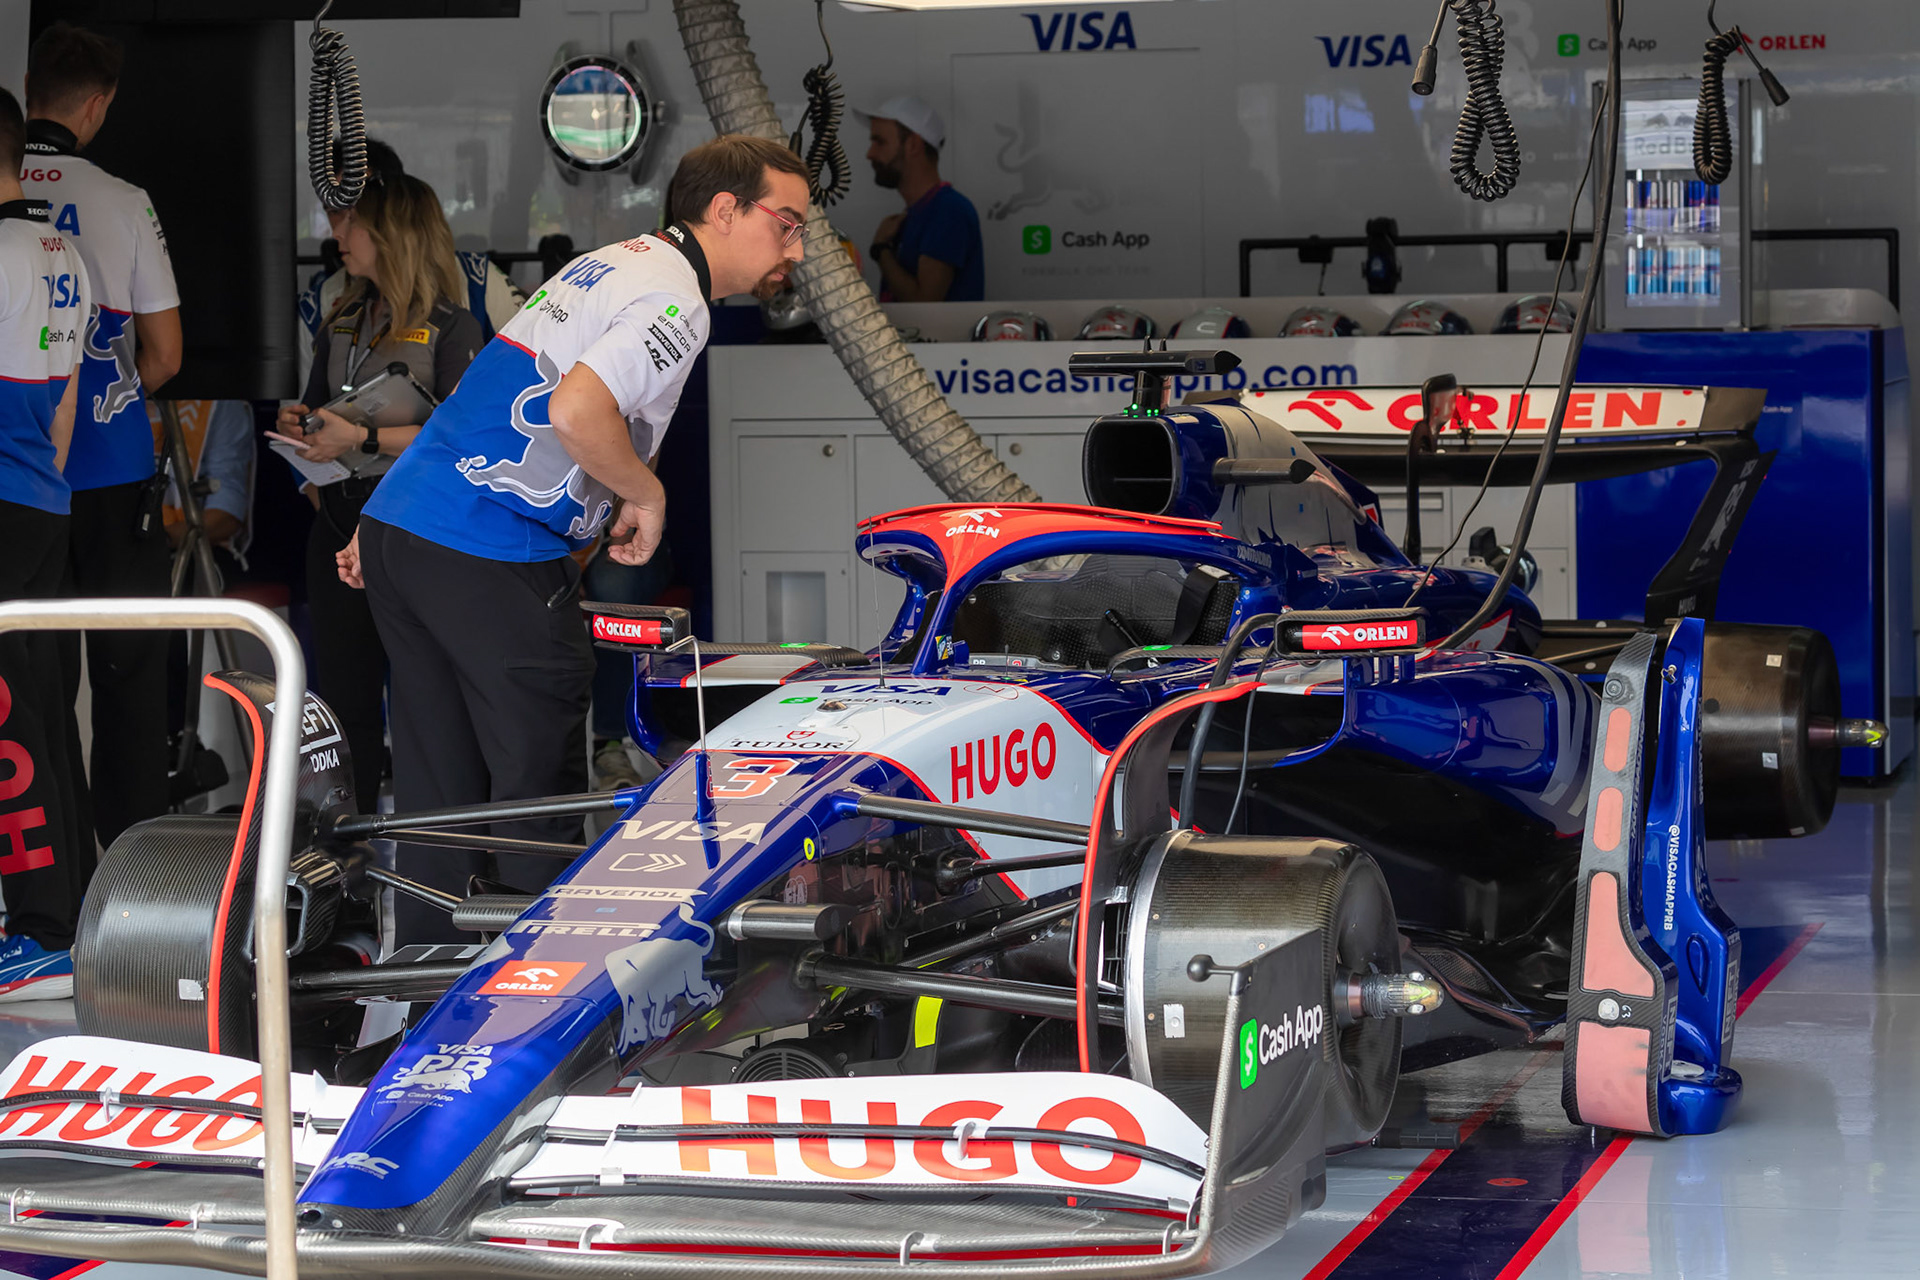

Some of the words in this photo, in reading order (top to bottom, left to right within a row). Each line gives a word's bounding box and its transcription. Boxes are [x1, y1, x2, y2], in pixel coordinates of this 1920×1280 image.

[1021, 11, 1137, 52] VISA
[1314, 34, 1411, 67] VISA
[1627, 37, 1657, 51] App
[1760, 34, 1826, 51] ORLEN
[20, 169, 62, 182] UGO
[1062, 231, 1107, 248] Cash
[1112, 230, 1150, 250] App
[560, 256, 616, 292] VISA
[550, 303, 569, 323] App
[936, 359, 1358, 399] visacashapb.com
[945, 525, 1001, 539] ORLEN
[606, 621, 642, 638] ORLEN
[1353, 626, 1408, 642] ORLEN
[818, 684, 953, 696] VISA
[302, 702, 330, 738] EFT
[730, 740, 845, 750] TUDOR
[310, 748, 340, 773] ODKA
[950, 722, 1056, 804] HUGO
[695, 758, 800, 800] 3
[619, 820, 767, 845] VISA
[1663, 824, 1681, 931] @VISACASHAPPRB
[556, 887, 686, 900] RAVENOL
[507, 920, 662, 938] PIRELLI
[495, 983, 555, 991] ORLEN
[1258, 1013, 1293, 1065] Cash
[1294, 1004, 1323, 1049] App
[1665, 1004, 1677, 1069] NEFT
[437, 1043, 494, 1056] VISA
[0, 1055, 264, 1152] HUGO
[434, 1094, 454, 1102] App
[679, 1086, 1147, 1186] HUGO
